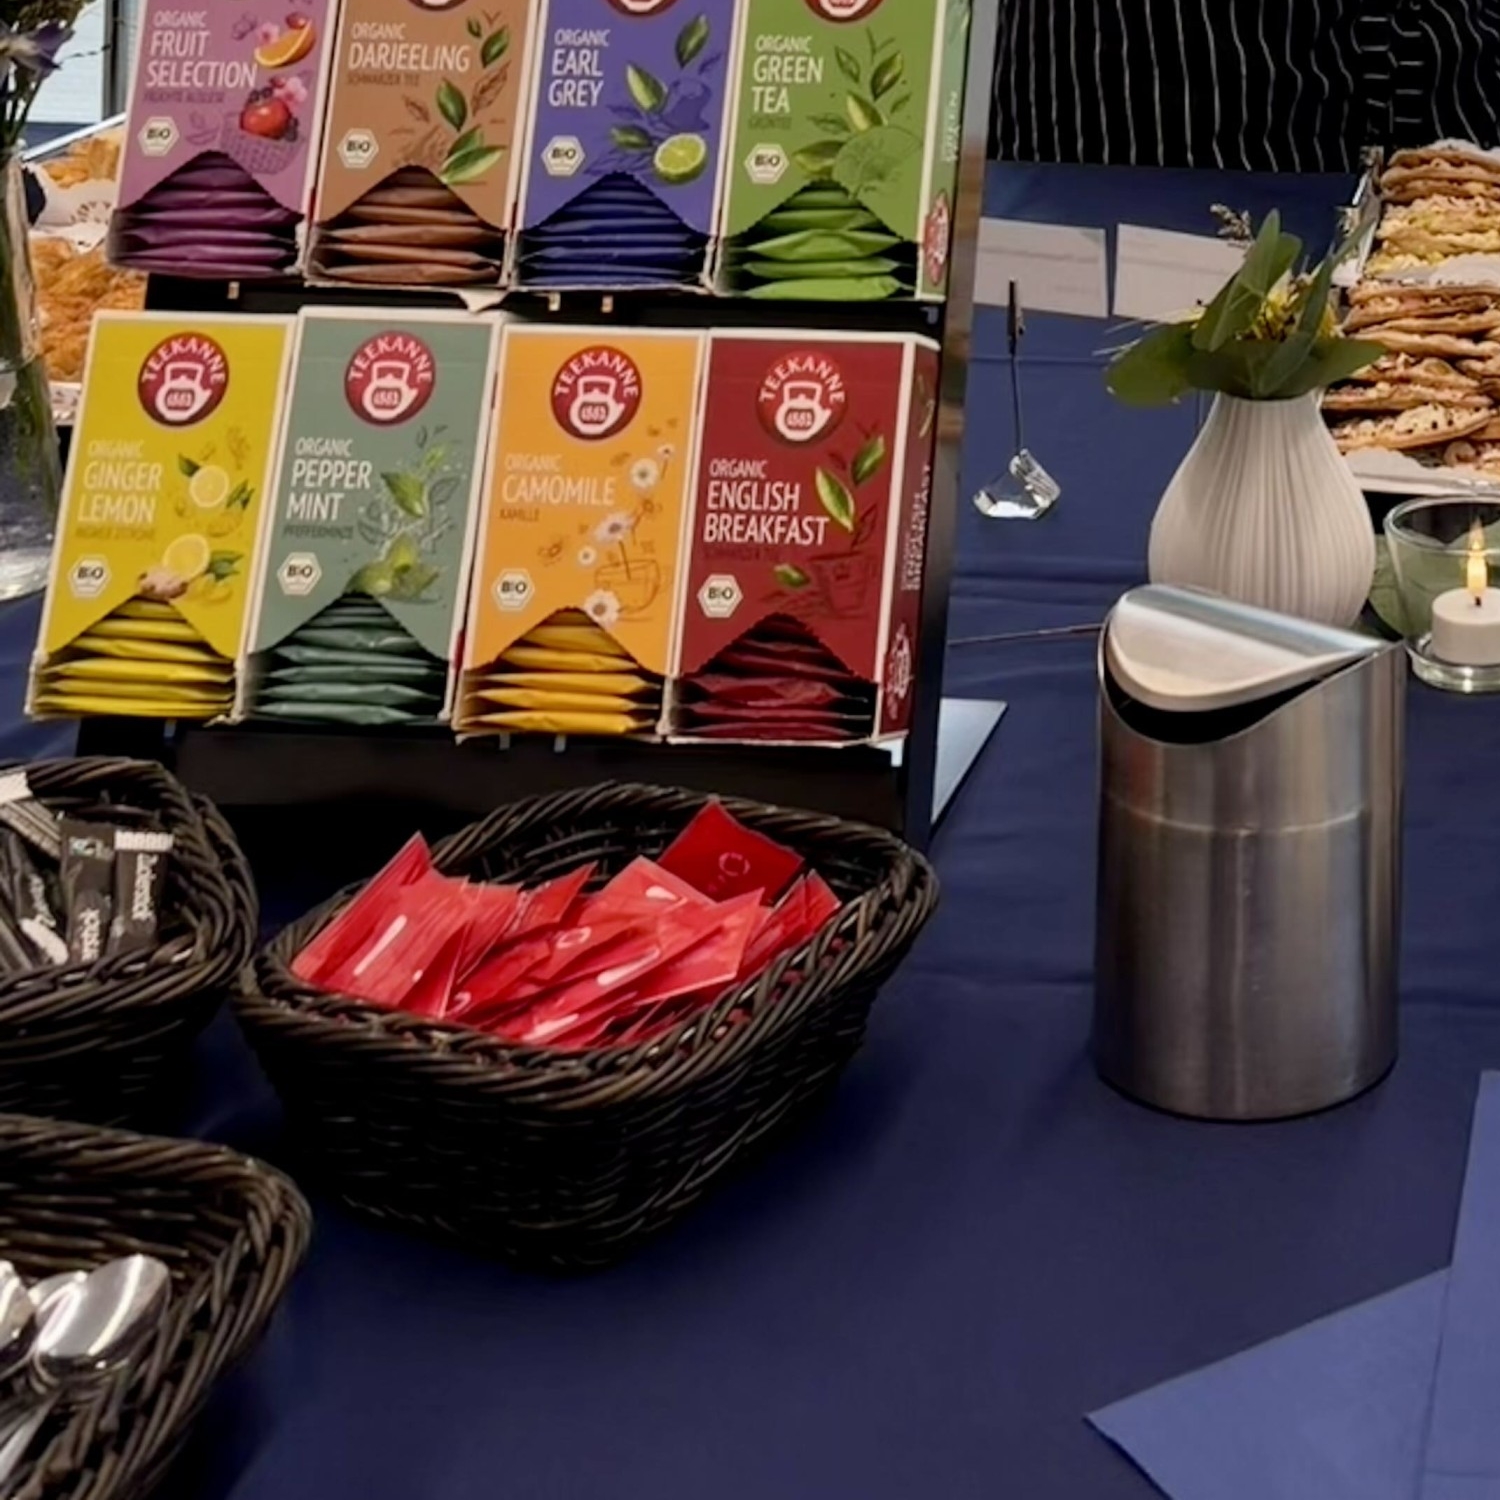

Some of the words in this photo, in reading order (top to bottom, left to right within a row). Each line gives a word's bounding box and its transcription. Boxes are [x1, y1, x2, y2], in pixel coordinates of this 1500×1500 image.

[153, 11, 208, 28] ORGANIC
[352, 22, 407, 40] ORGANIC
[150, 30, 211, 57] FRUIT
[554, 28, 611, 46] ORGANIC
[755, 34, 813, 53] ORGANIC
[349, 43, 471, 73] DARJEELING
[552, 49, 604, 76] EARL
[753, 55, 824, 84] GREEN
[146, 61, 258, 88] SELECTION
[548, 79, 604, 107] GREY
[751, 86, 791, 114] TEA
[142, 337, 226, 384] TEEKANNE
[347, 335, 433, 382] TEEKANNE
[554, 351, 639, 398] TEEKANNE
[759, 356, 845, 403] TEEKANNE
[295, 437, 353, 457] ORGANIC
[83, 460, 162, 490] GINGER
[291, 459, 372, 489] PEPPER
[504, 453, 561, 472] ORGANIC
[709, 458, 767, 479] ORGANIC
[502, 475, 616, 506] CAMOMILE
[707, 481, 800, 512] ENGLISH
[77, 494, 156, 523] LEMON
[286, 493, 344, 521] MINT
[703, 512, 829, 547] BREAKFAST
